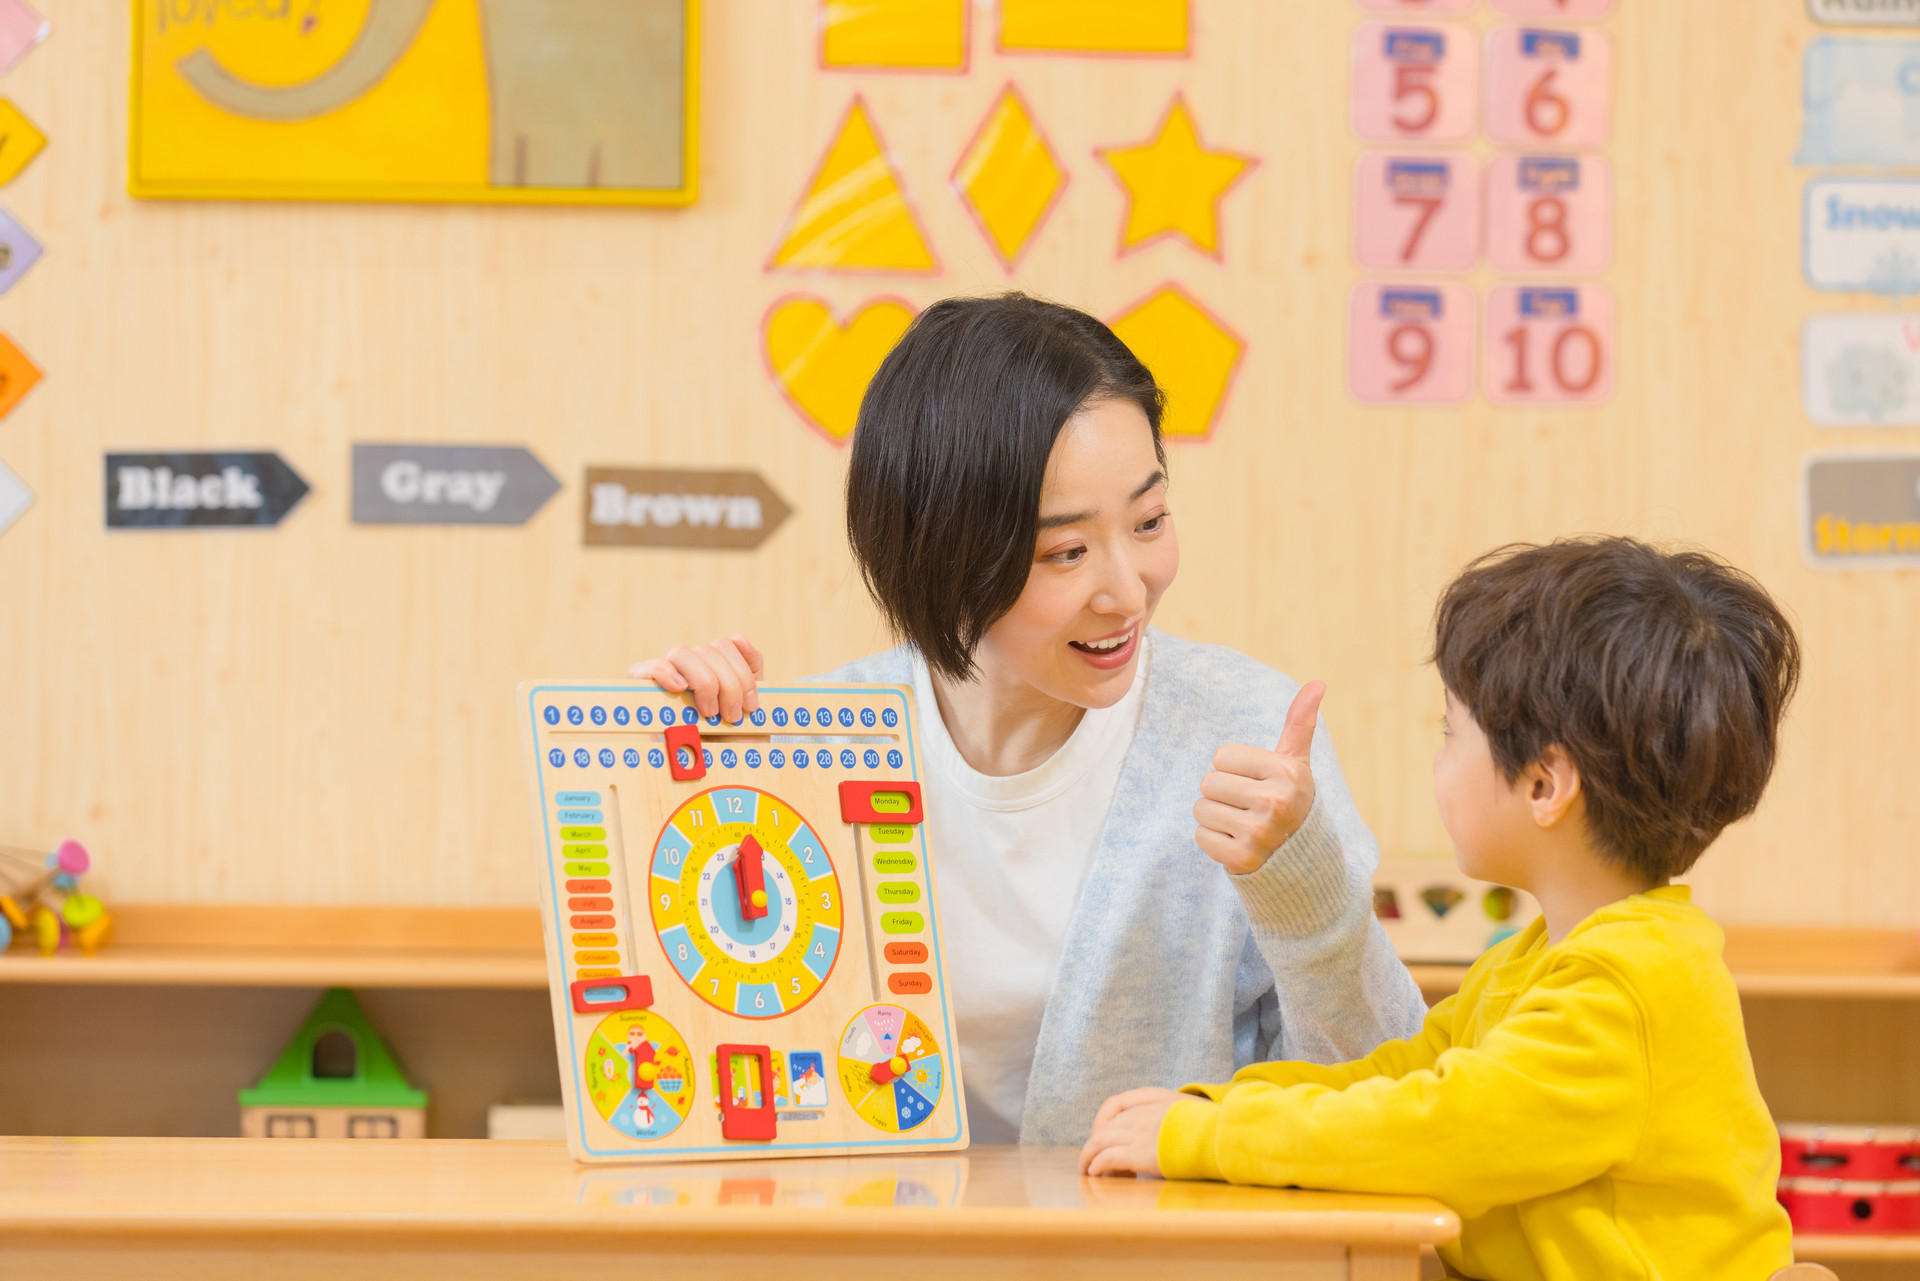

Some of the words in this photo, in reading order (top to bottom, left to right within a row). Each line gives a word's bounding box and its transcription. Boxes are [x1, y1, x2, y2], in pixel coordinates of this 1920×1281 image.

[1392, 65, 1438, 132] 5
[1523, 69, 1570, 136] 6
[1393, 195, 1443, 262] 7
[1525, 195, 1572, 263] 8
[1388, 325, 1435, 394] 9
[1504, 326, 1602, 393] 10
[116, 464, 265, 511] Black
[380, 459, 507, 513] Gray
[590, 481, 764, 530] Brown
[548, 709, 555, 722] 1
[572, 709, 580, 722] 2
[595, 709, 603, 722] 3
[618, 709, 626, 722] 4
[641, 709, 649, 722] 5
[664, 709, 672, 722] 6
[686, 709, 694, 722] 7
[752, 711, 765, 723] 10
[774, 711, 786, 723] 11
[796, 711, 809, 723] 12
[818, 711, 831, 723] 13
[840, 711, 853, 723] 14
[862, 711, 874, 723] 15
[884, 711, 896, 723] 16
[551, 752, 563, 764] 17
[575, 752, 588, 764] 18
[600, 752, 613, 764] 19
[625, 752, 638, 764] 20
[650, 752, 662, 764] 21
[704, 752, 712, 765] 3
[723, 753, 736, 765] 24
[747, 753, 760, 765] 25
[771, 753, 784, 765] 26
[795, 753, 807, 765] 27
[819, 753, 832, 765] 28
[842, 753, 855, 765] 29
[866, 753, 879, 765] 30
[889, 753, 901, 765] 31
[726, 796, 744, 814] 12
[689, 810, 704, 827] 11
[771, 810, 779, 827] 1
[878, 828, 904, 836] Tuesday
[663, 848, 680, 866] 10
[803, 846, 814, 864] 2
[660, 893, 671, 912] 9
[821, 892, 832, 910] 3
[678, 942, 688, 961] 8
[814, 941, 826, 958] 4
[709, 978, 720, 996] 7
[791, 977, 801, 995] 5
[754, 991, 765, 1010] 6
[914, 1020, 932, 1042] Overcast
